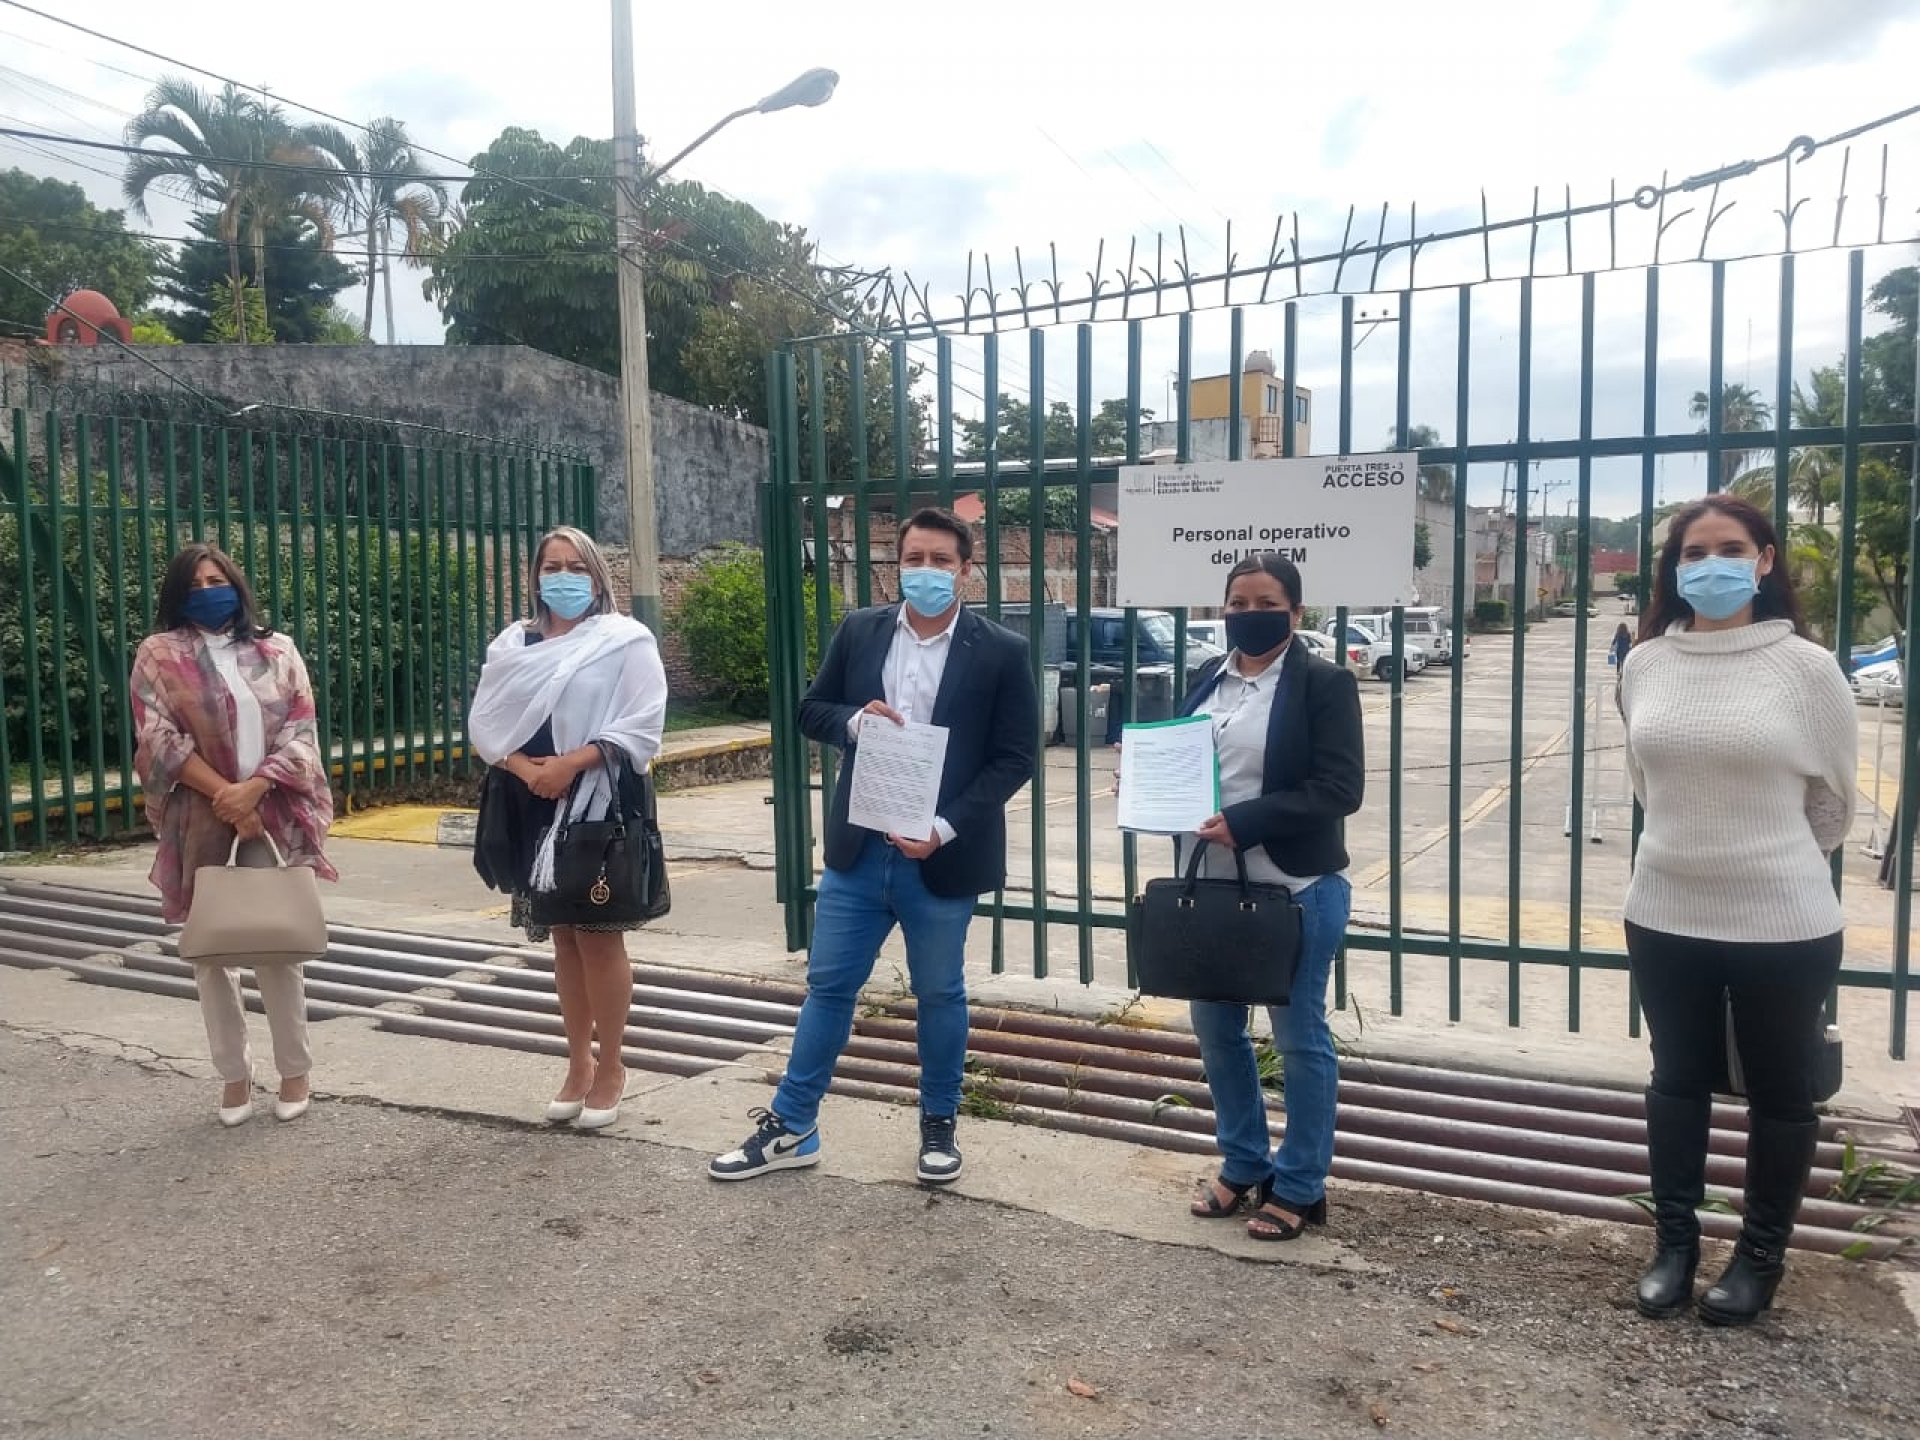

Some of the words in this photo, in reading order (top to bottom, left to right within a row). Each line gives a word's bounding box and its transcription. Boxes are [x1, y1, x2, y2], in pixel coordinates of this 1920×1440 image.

[1325, 464, 1362, 472] PUERTA
[1365, 462, 1389, 471] TRES
[1322, 470, 1405, 488] ACCESO
[1172, 525, 1252, 542] Personal
[1259, 523, 1351, 543] operativo
[1211, 549, 1238, 564] del
